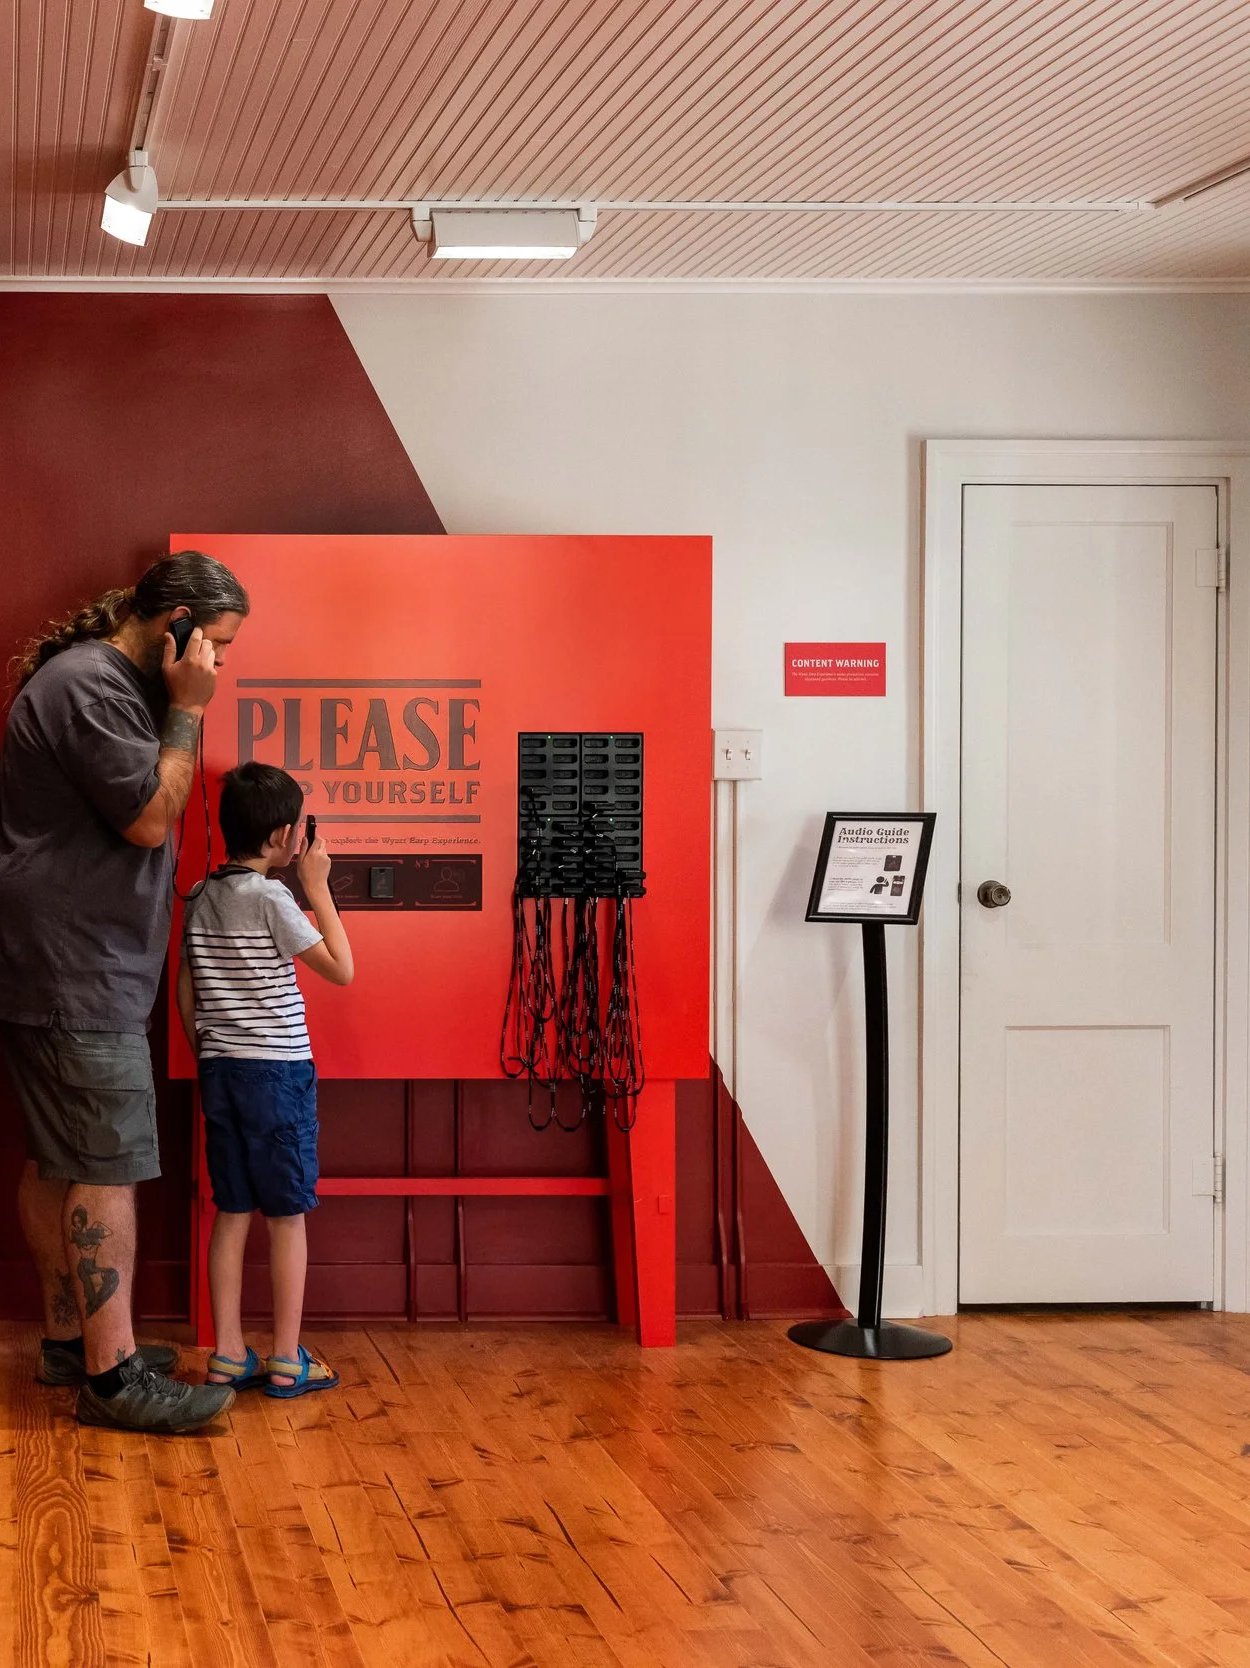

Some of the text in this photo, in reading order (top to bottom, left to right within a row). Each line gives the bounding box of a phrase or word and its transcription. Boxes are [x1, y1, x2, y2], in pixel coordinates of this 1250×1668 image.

[791, 659, 880, 668] CONTENT WARNING
[236, 697, 482, 772] PLEASE
[322, 780, 481, 804] YOURSELF
[839, 827, 910, 836] Audio Guide
[330, 836, 363, 846] explore
[364, 836, 379, 844] the
[381, 837, 407, 846] Wyatt
[409, 836, 430, 846] Earp
[432, 836, 481, 846] Experience.
[837, 835, 910, 844] Instructions
